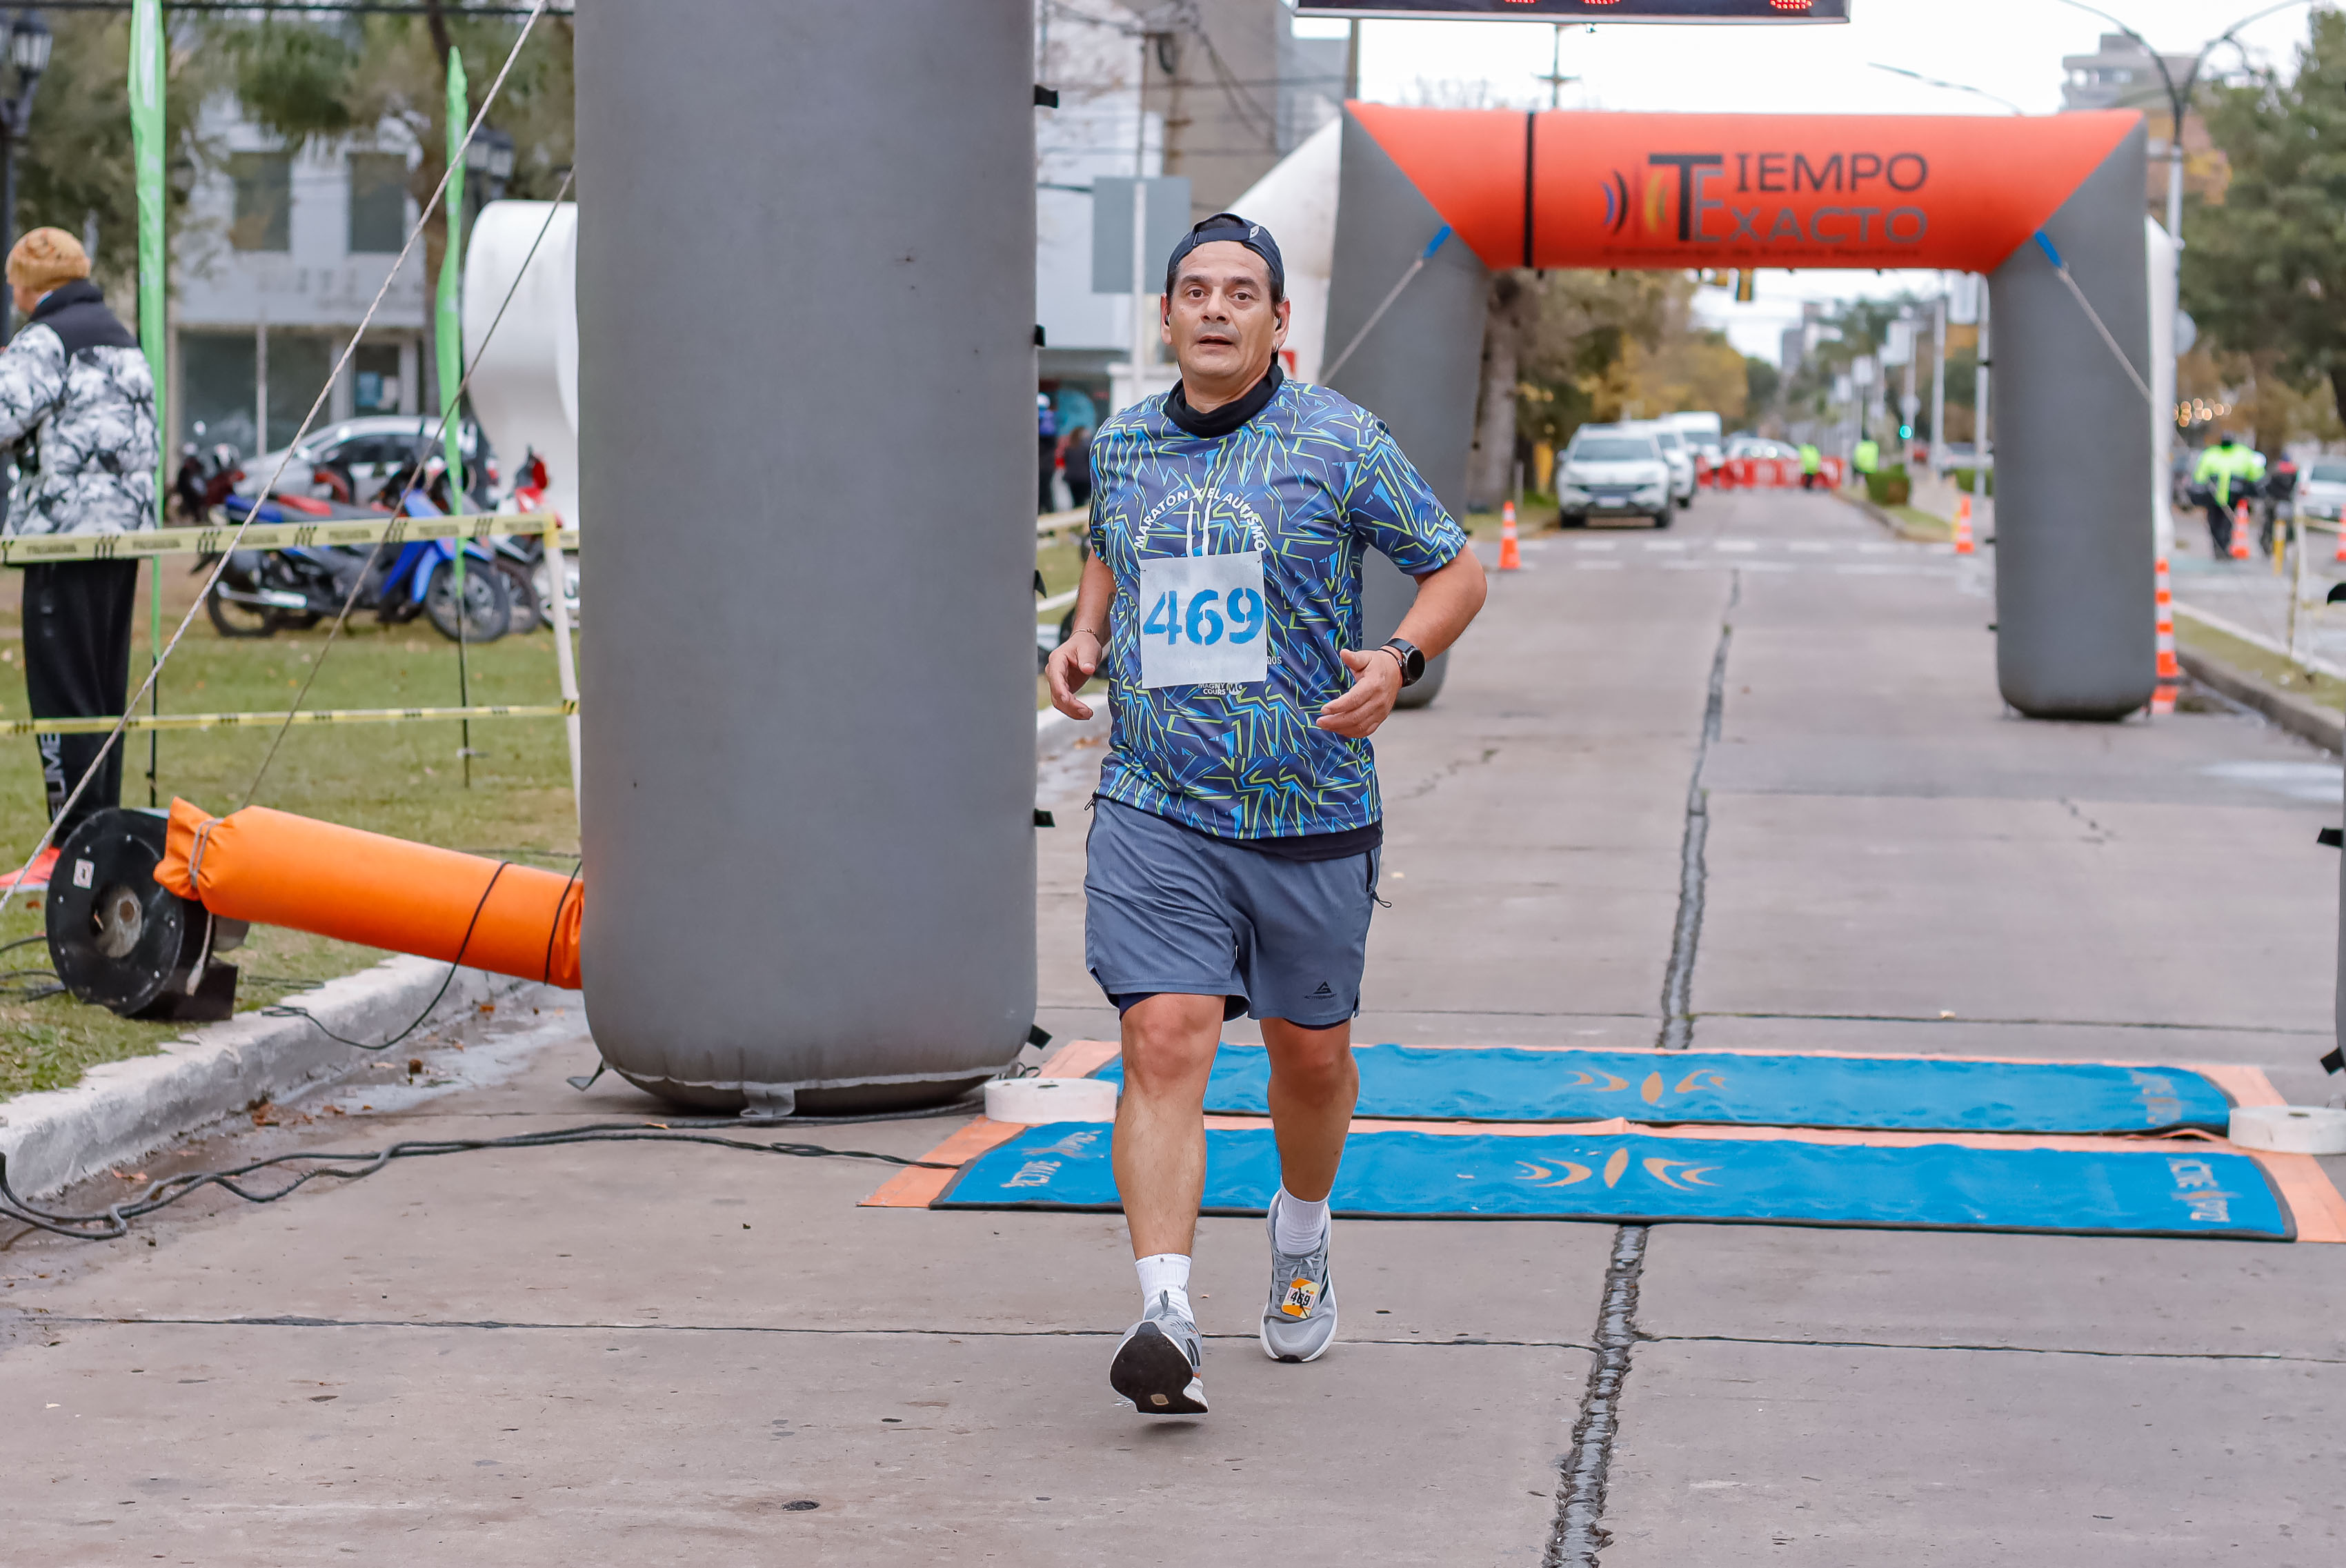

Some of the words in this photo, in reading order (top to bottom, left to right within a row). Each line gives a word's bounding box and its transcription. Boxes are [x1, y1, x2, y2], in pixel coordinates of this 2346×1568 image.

[1649, 152, 1929, 241] TIEMPO
[1693, 168, 1929, 244] EXACTO
[1134, 490, 1189, 549] MARATON
[1194, 488, 1204, 498] X
[1206, 487, 1221, 500] EL
[1222, 492, 1266, 552] AUTISMO
[1143, 587, 1264, 646] 469
[1290, 1290, 1311, 1307] 469
